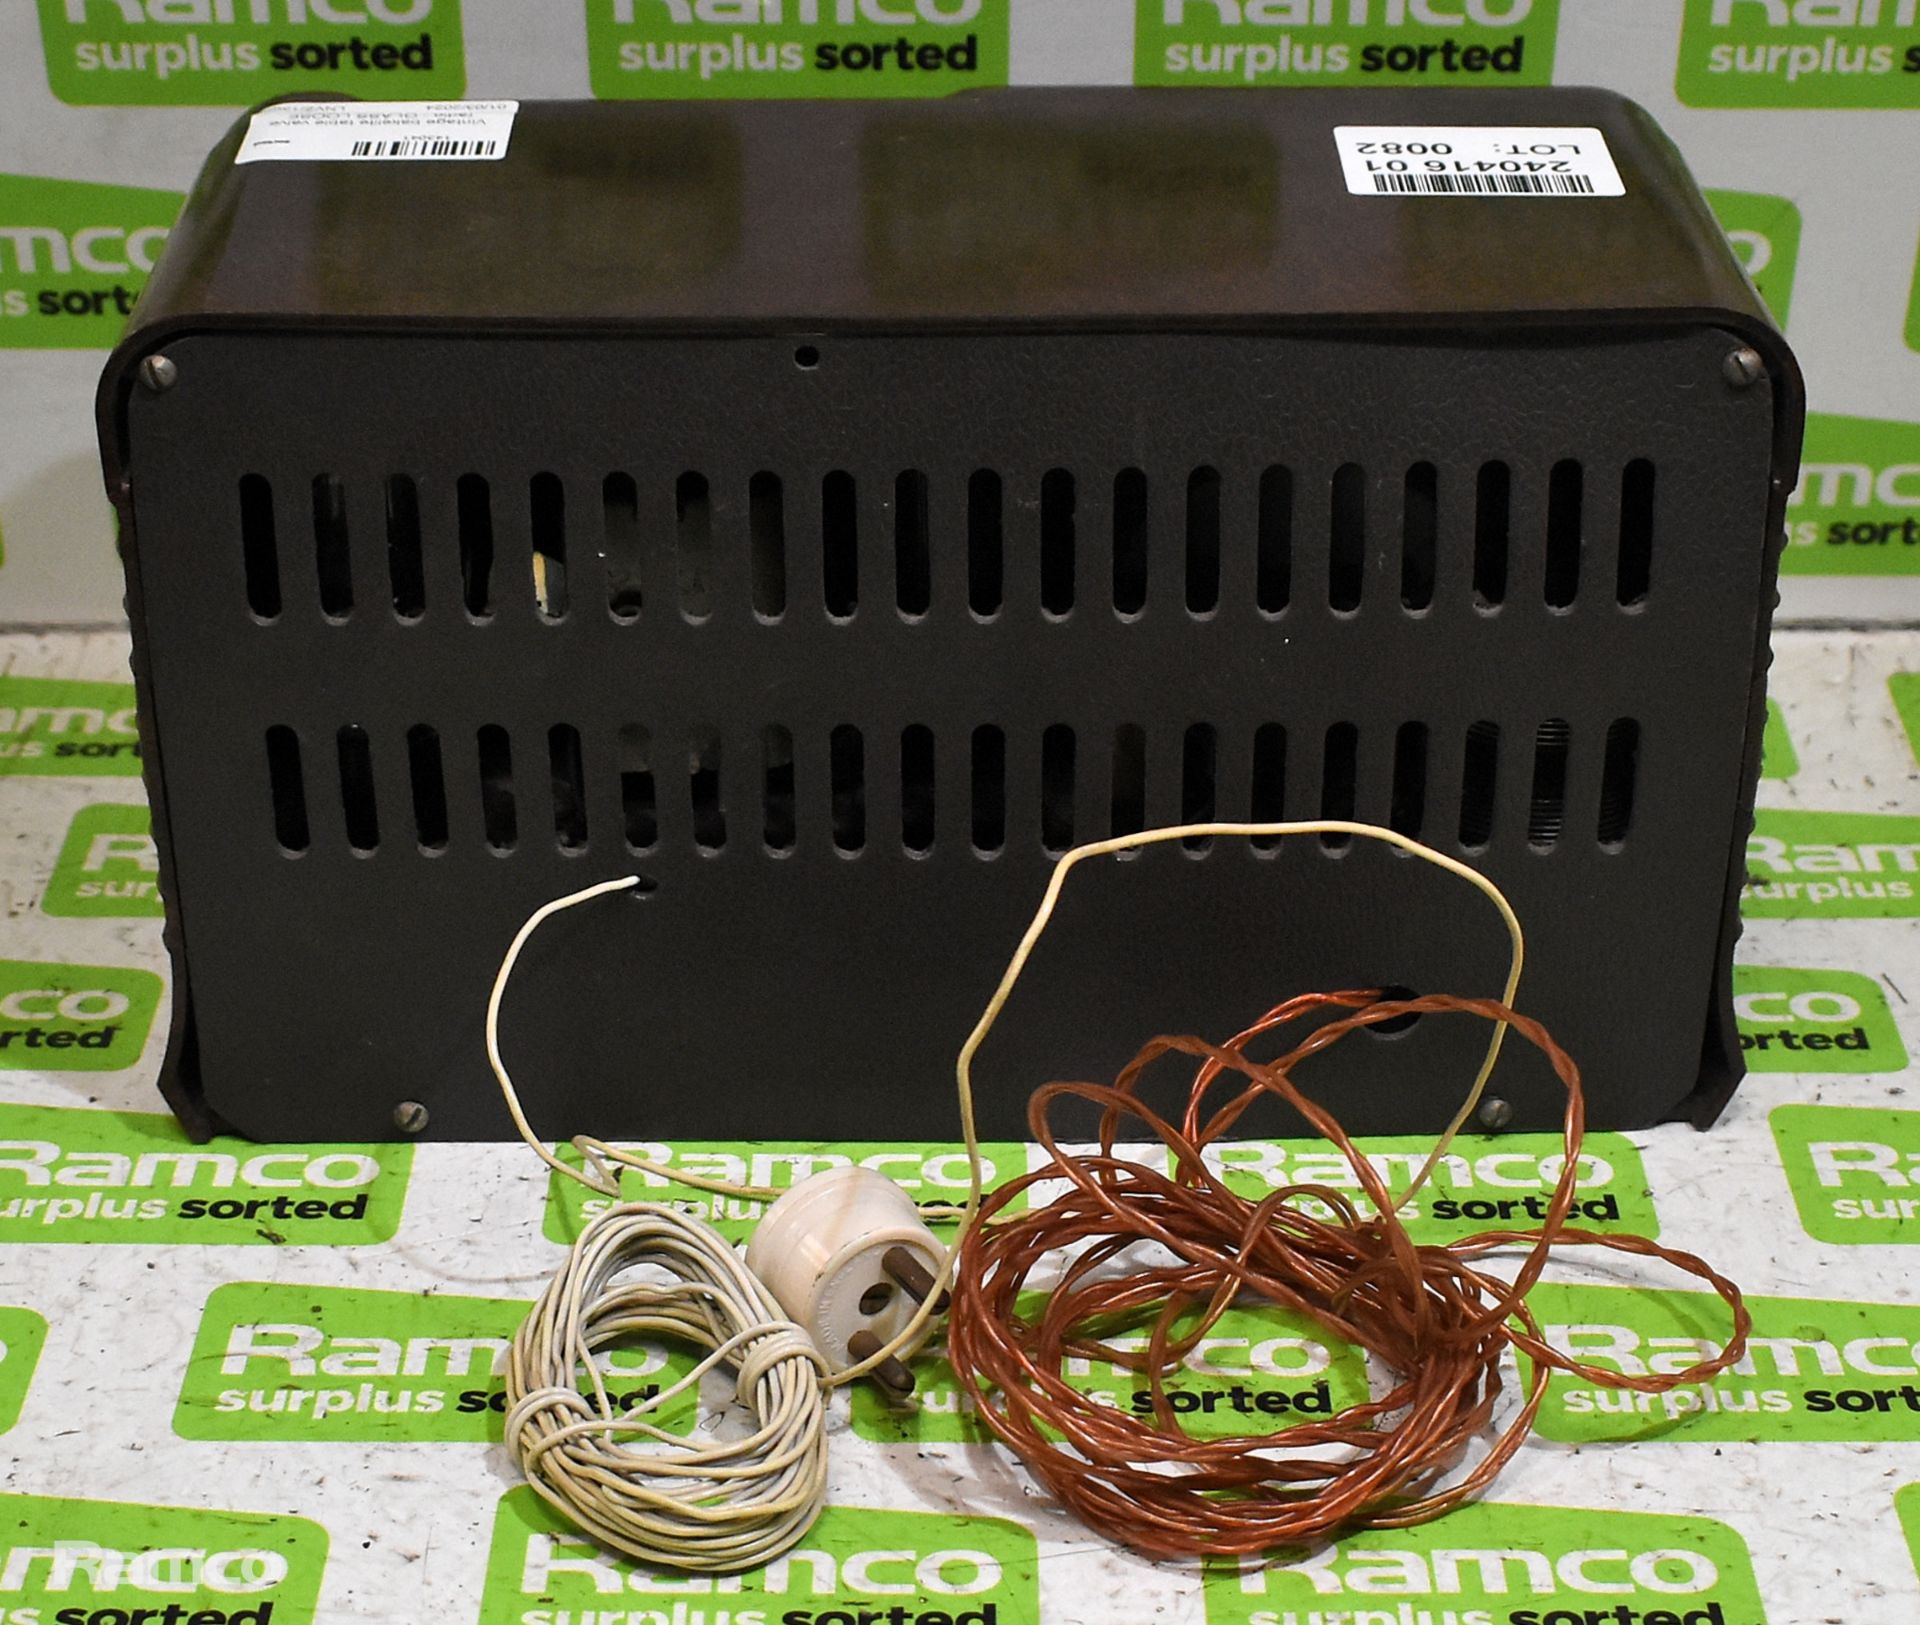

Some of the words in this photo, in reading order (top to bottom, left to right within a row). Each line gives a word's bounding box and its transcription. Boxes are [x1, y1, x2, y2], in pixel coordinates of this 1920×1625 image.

[75, 33, 261, 79] surplus
[270, 32, 433, 70] sorted
[619, 33, 803, 79] surplus
[815, 34, 977, 70] sorted
[1165, 34, 1350, 81] surplus
[1361, 36, 1524, 73] sorted
[1709, 37, 1894, 82] surplus
[1355, 142, 1452, 154] 0082
[1366, 160, 1408, 172] 01
[1424, 160, 1572, 172] 240416
[1493, 143, 1581, 155] LOT:
[37, 284, 140, 316] sort
[1200, 1142, 1614, 1188] Ramco
[177, 1193, 368, 1220] sorted
[220, 1324, 669, 1377] Ramo
[1544, 1324, 1920, 1376] Ramc
[213, 1383, 447, 1420] surplus
[1131, 1379, 1333, 1414] sorted
[1562, 1383, 1793, 1420] surplus
[1239, 1538, 1718, 1594] Ramco
